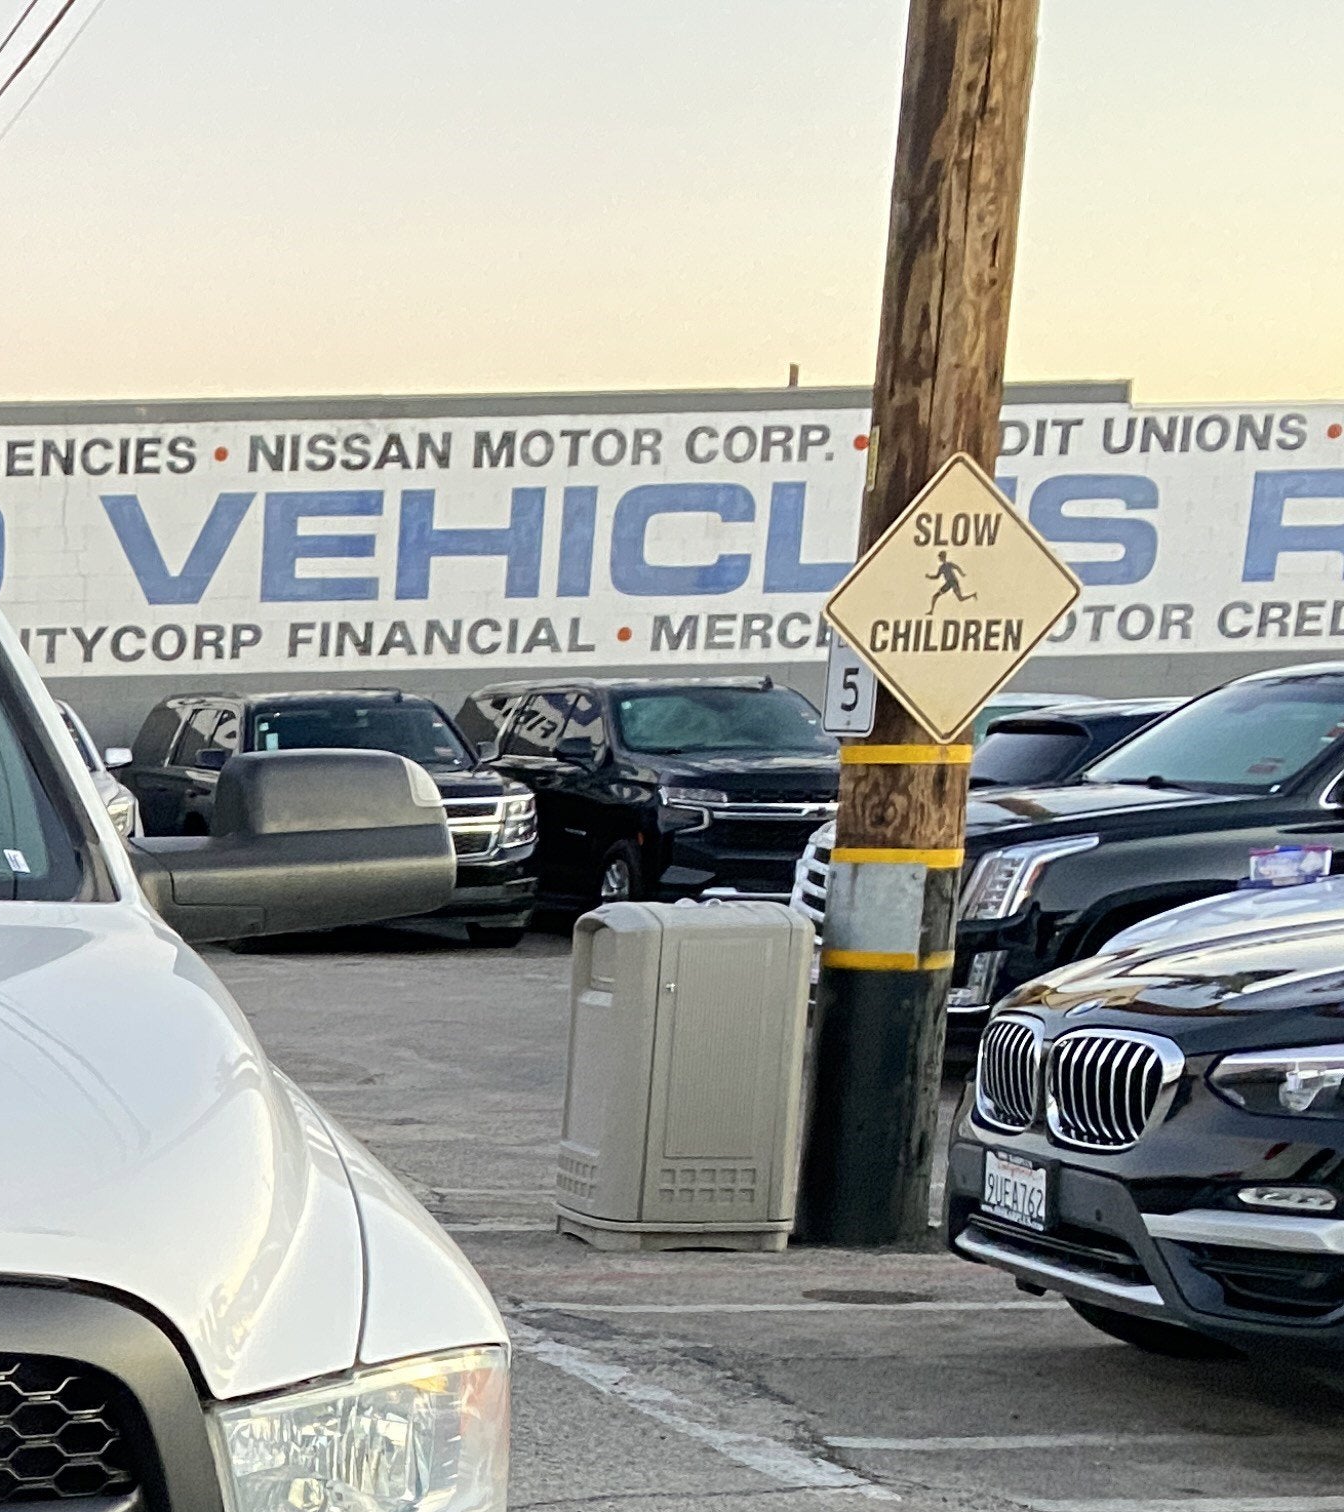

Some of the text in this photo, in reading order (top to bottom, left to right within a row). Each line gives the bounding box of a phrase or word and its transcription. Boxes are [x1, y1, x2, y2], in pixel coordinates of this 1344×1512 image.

[248, 430, 451, 474] NISSAN
[472, 427, 663, 469] MOTOR
[685, 424, 834, 464] CORP.
[1103, 413, 1308, 455] UNIONS
[99, 473, 1159, 606] VEHICLS
[913, 513, 1002, 548] SLOW
[288, 616, 595, 659] FINANCIAL
[868, 618, 1024, 653] CHILDREN
[840, 667, 860, 713] 5
